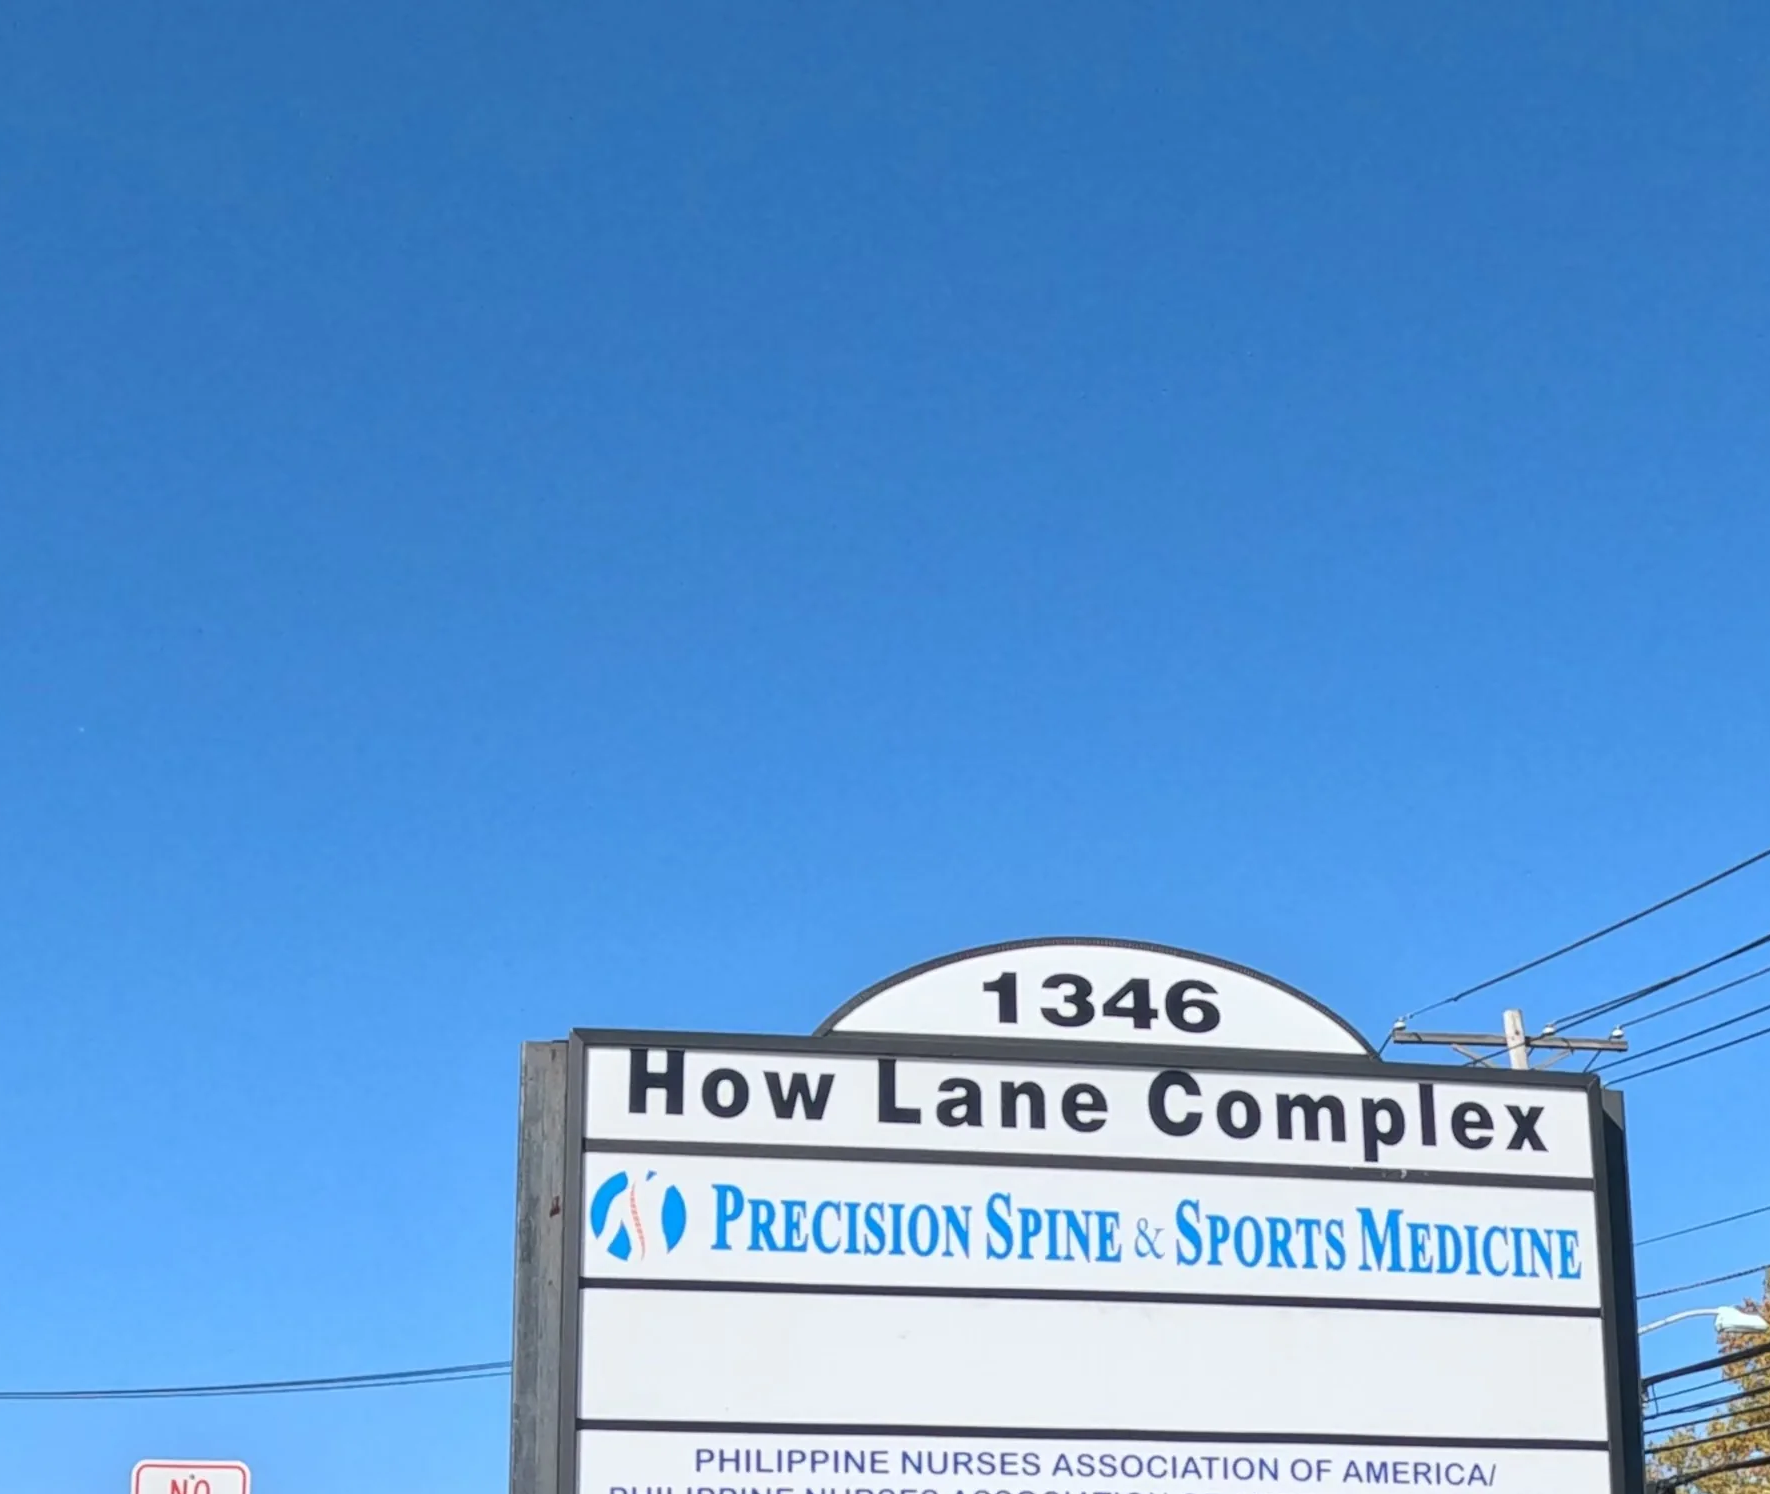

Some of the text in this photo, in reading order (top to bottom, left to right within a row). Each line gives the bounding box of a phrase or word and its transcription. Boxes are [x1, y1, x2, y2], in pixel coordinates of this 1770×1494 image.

[983, 971, 1221, 1034] 1346
[626, 1047, 1549, 1163] How Lane Complex
[711, 1183, 1581, 1280] PRECISION SPINE & SPORTS MEDICINE
[695, 1448, 1496, 1486] PHILIPPINE NURSES ASSOCIATION OF AMERICA/
